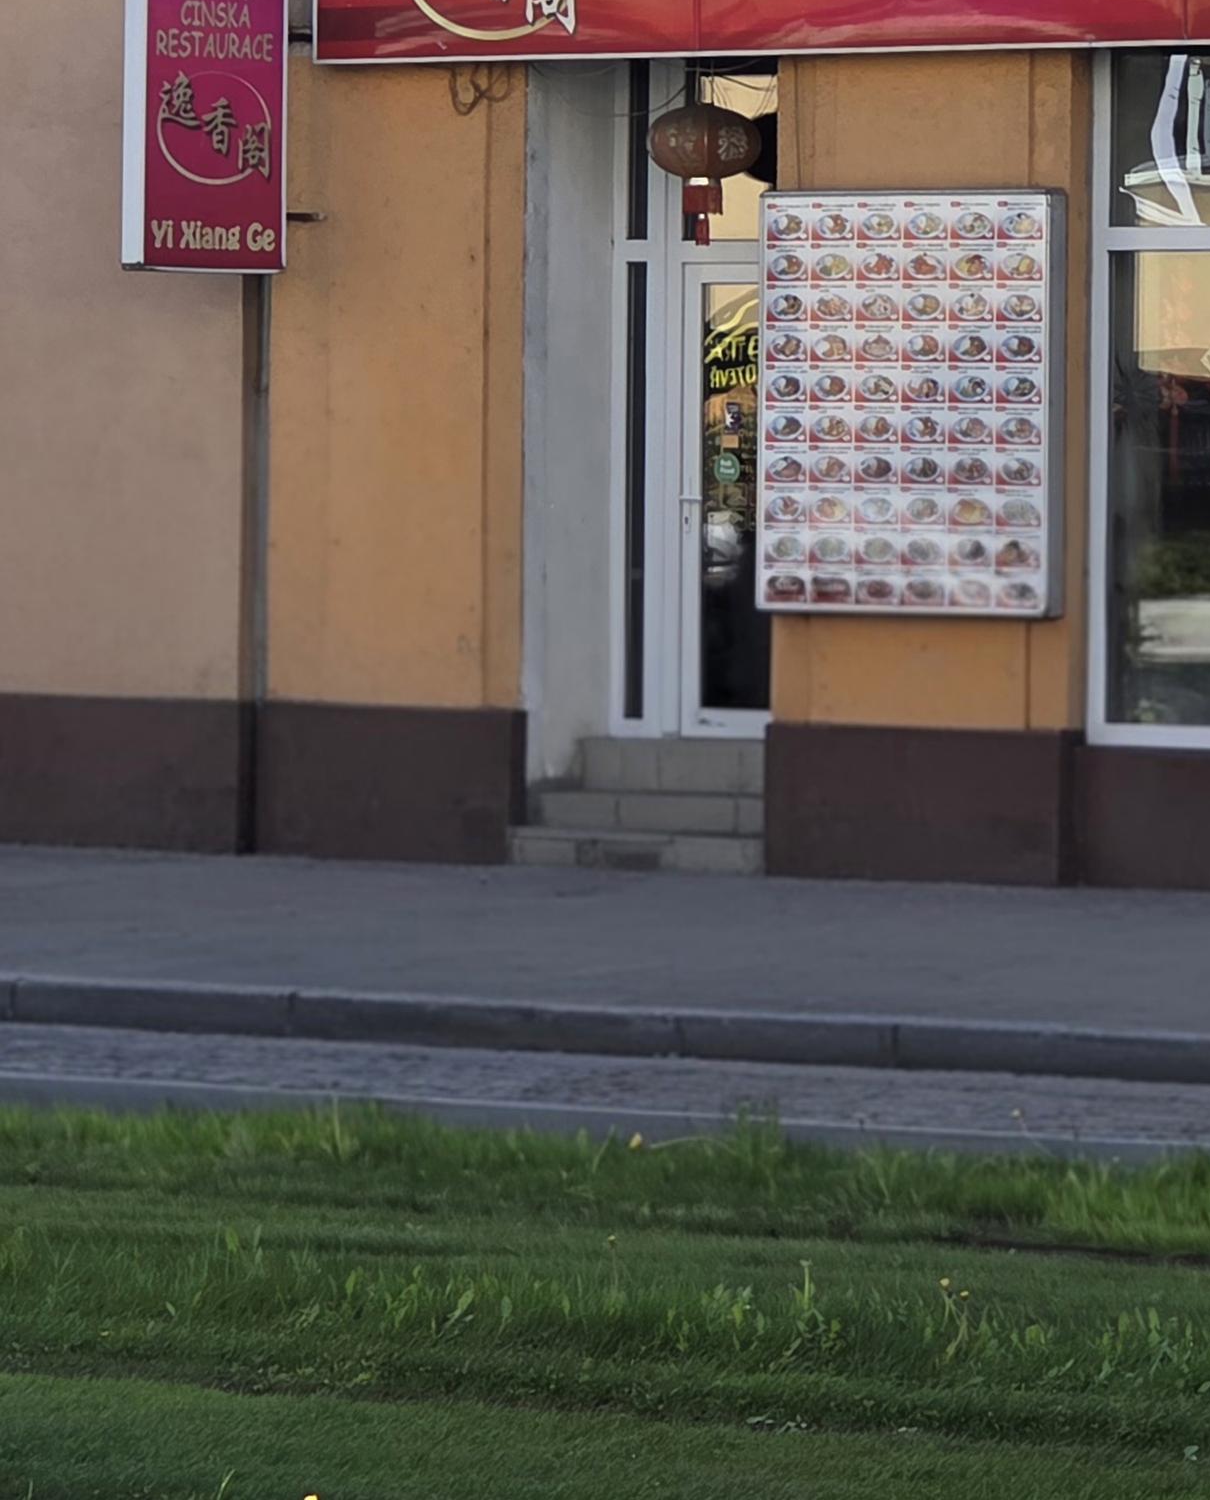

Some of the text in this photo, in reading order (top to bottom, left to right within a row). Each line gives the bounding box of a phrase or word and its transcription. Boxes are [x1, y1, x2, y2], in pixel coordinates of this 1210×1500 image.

[155, 28, 274, 62] RESTAURACE
[151, 219, 276, 252] Yi Xiang Ge
